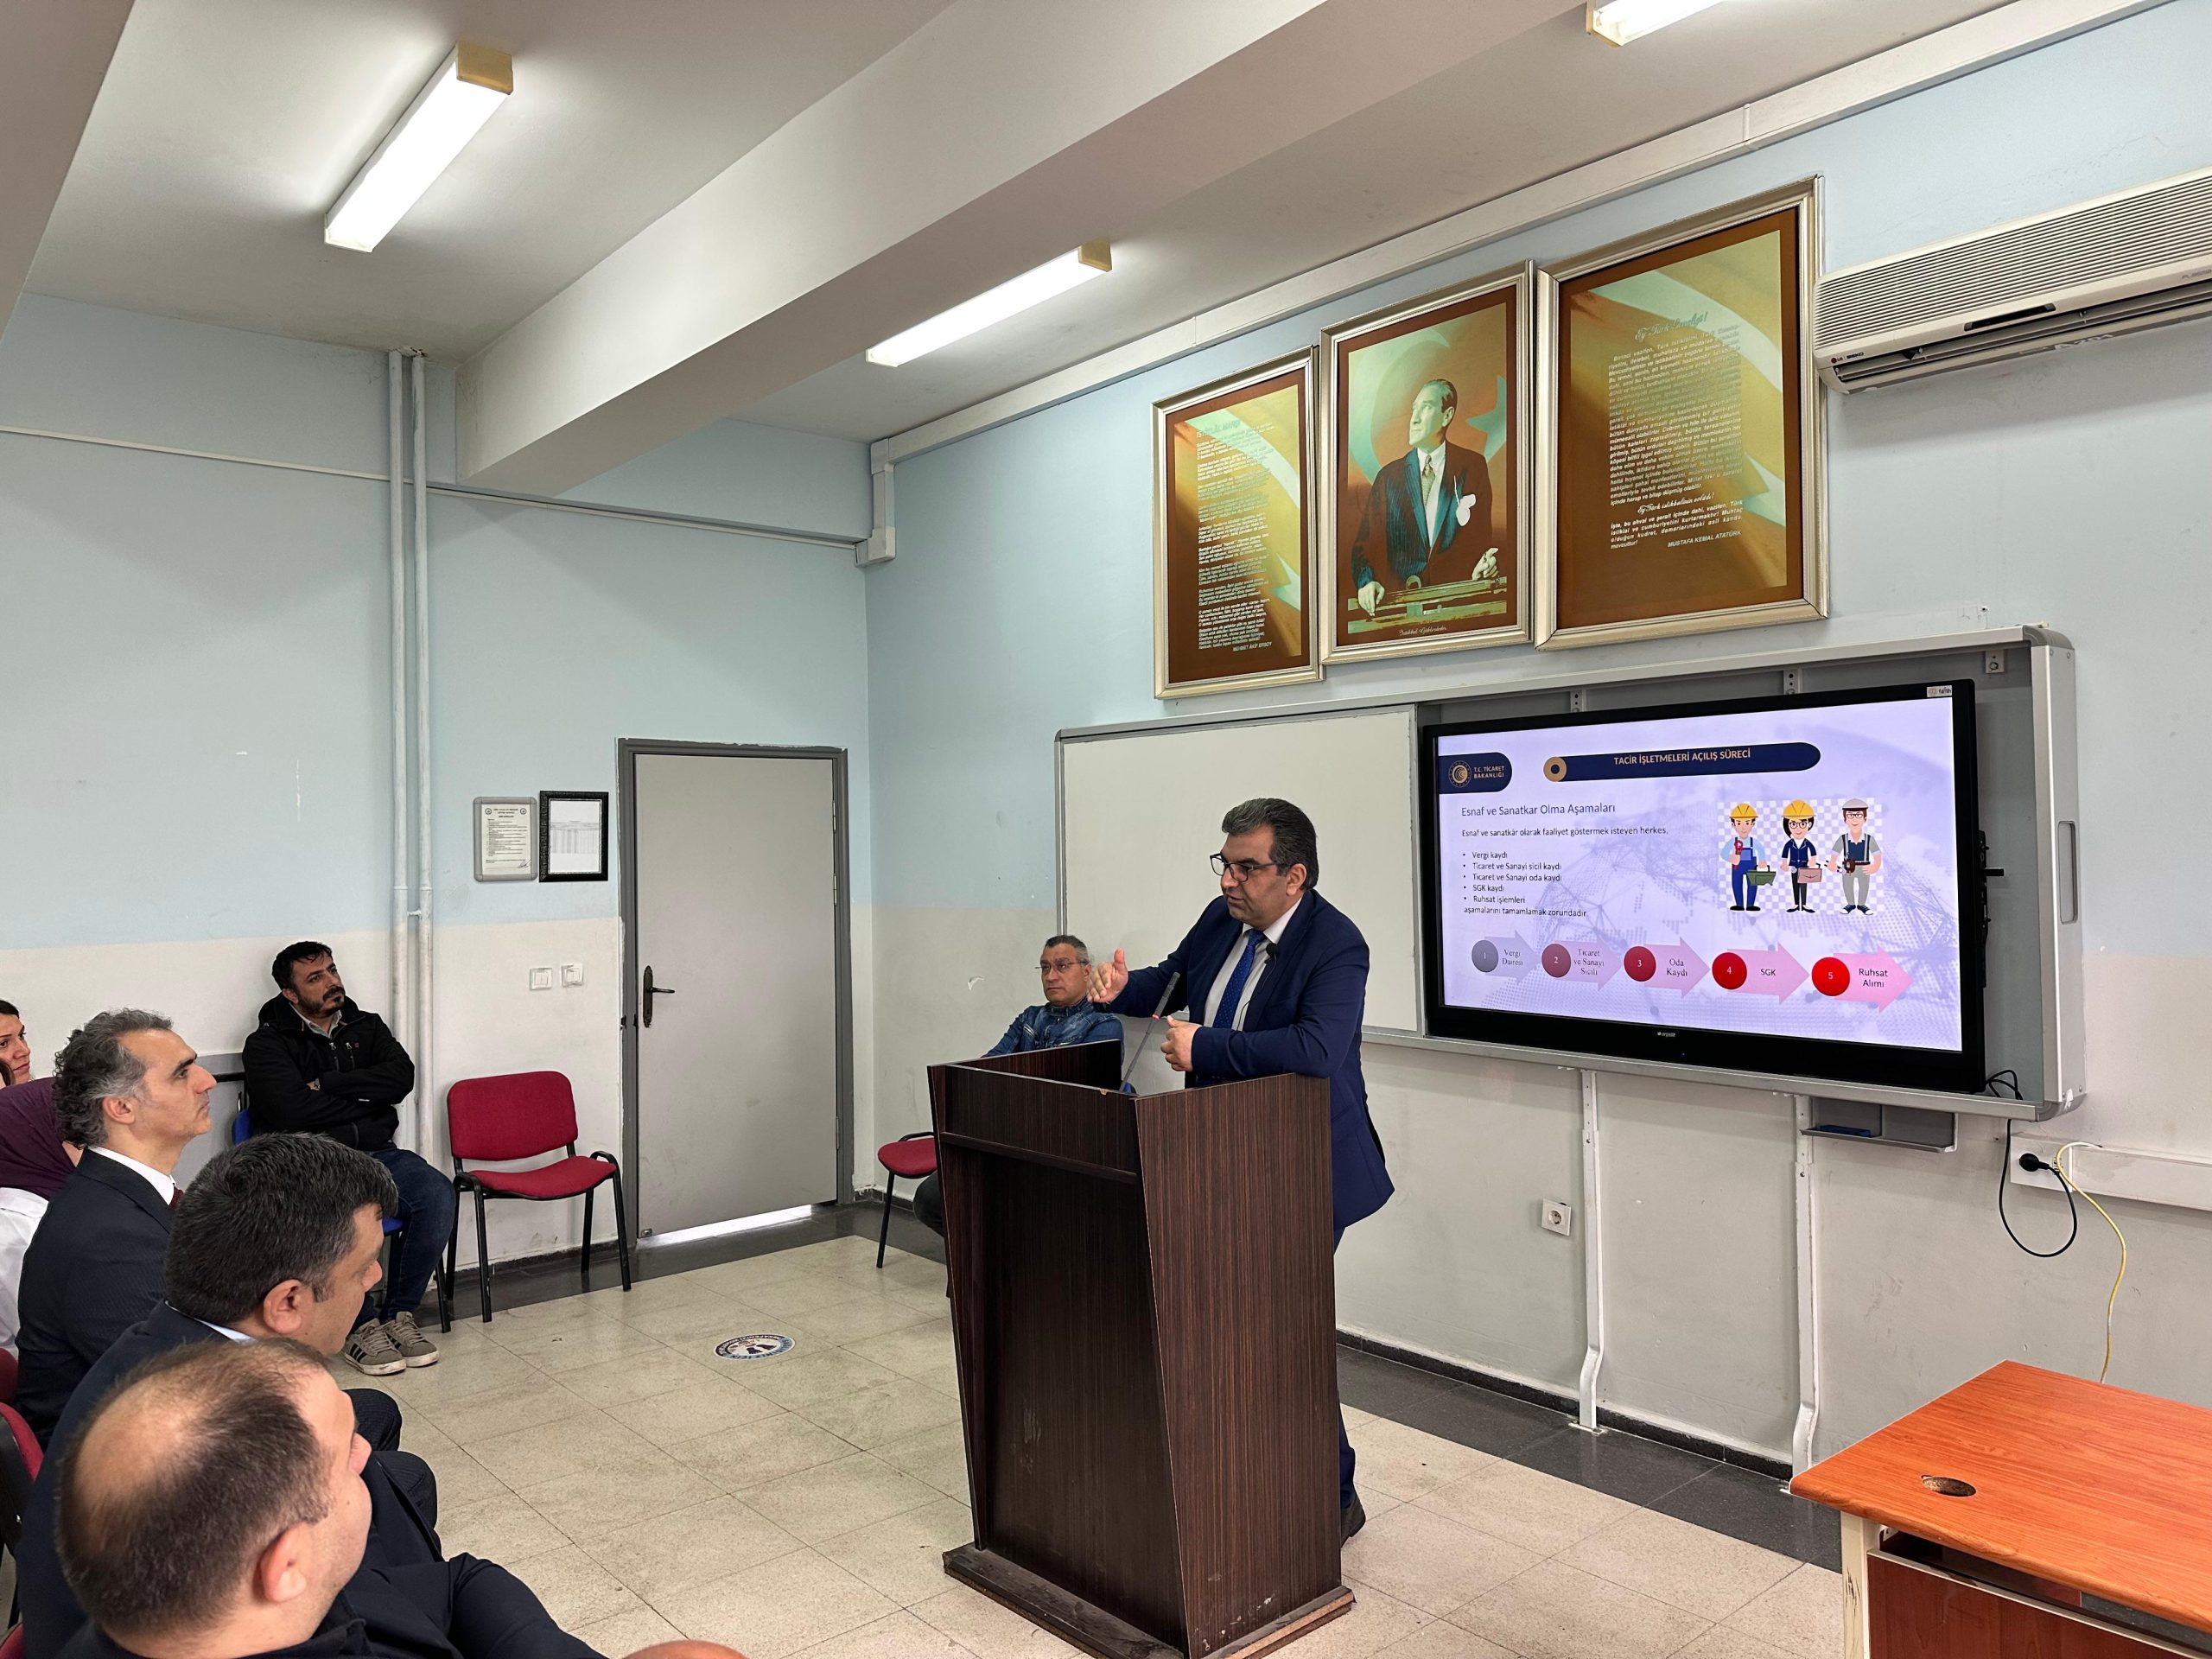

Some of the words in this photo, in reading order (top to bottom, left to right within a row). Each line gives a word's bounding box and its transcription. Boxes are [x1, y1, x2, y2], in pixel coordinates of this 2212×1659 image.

[1614, 755, 1637, 765] TACİR
[1639, 752, 1689, 765] İŞLETMELERİ
[1692, 751, 1718, 762] AÇILIŞ
[1719, 747, 1751, 760] SÜRECİ
[1462, 806, 1484, 816] Esnaf
[1499, 805, 1538, 816] Sanatkar
[1540, 804, 1565, 814] Olma
[1567, 803, 1615, 815] Aşamaları
[1520, 828, 1541, 836] olarak
[1542, 828, 1568, 838] faaliyet
[1570, 827, 1609, 837] göstermek
[1611, 827, 1637, 836] isteyen
[1491, 851, 1507, 860] kaydı
[1543, 862, 1561, 871] kaydı
[1497, 896, 1525, 905] işlemleri
[1504, 950, 1521, 958] Vergi
[1578, 949, 1600, 957] Ticaret
[1502, 957, 1523, 966] Dairesi
[1582, 958, 1605, 967] Sanayi
[1669, 958, 1684, 967] Oda
[1667, 968, 1688, 977] Kaydı
[1761, 968, 1776, 976] SGK
[1859, 968, 1888, 977] Ruhsat
[1863, 979, 1885, 988] Alımı
